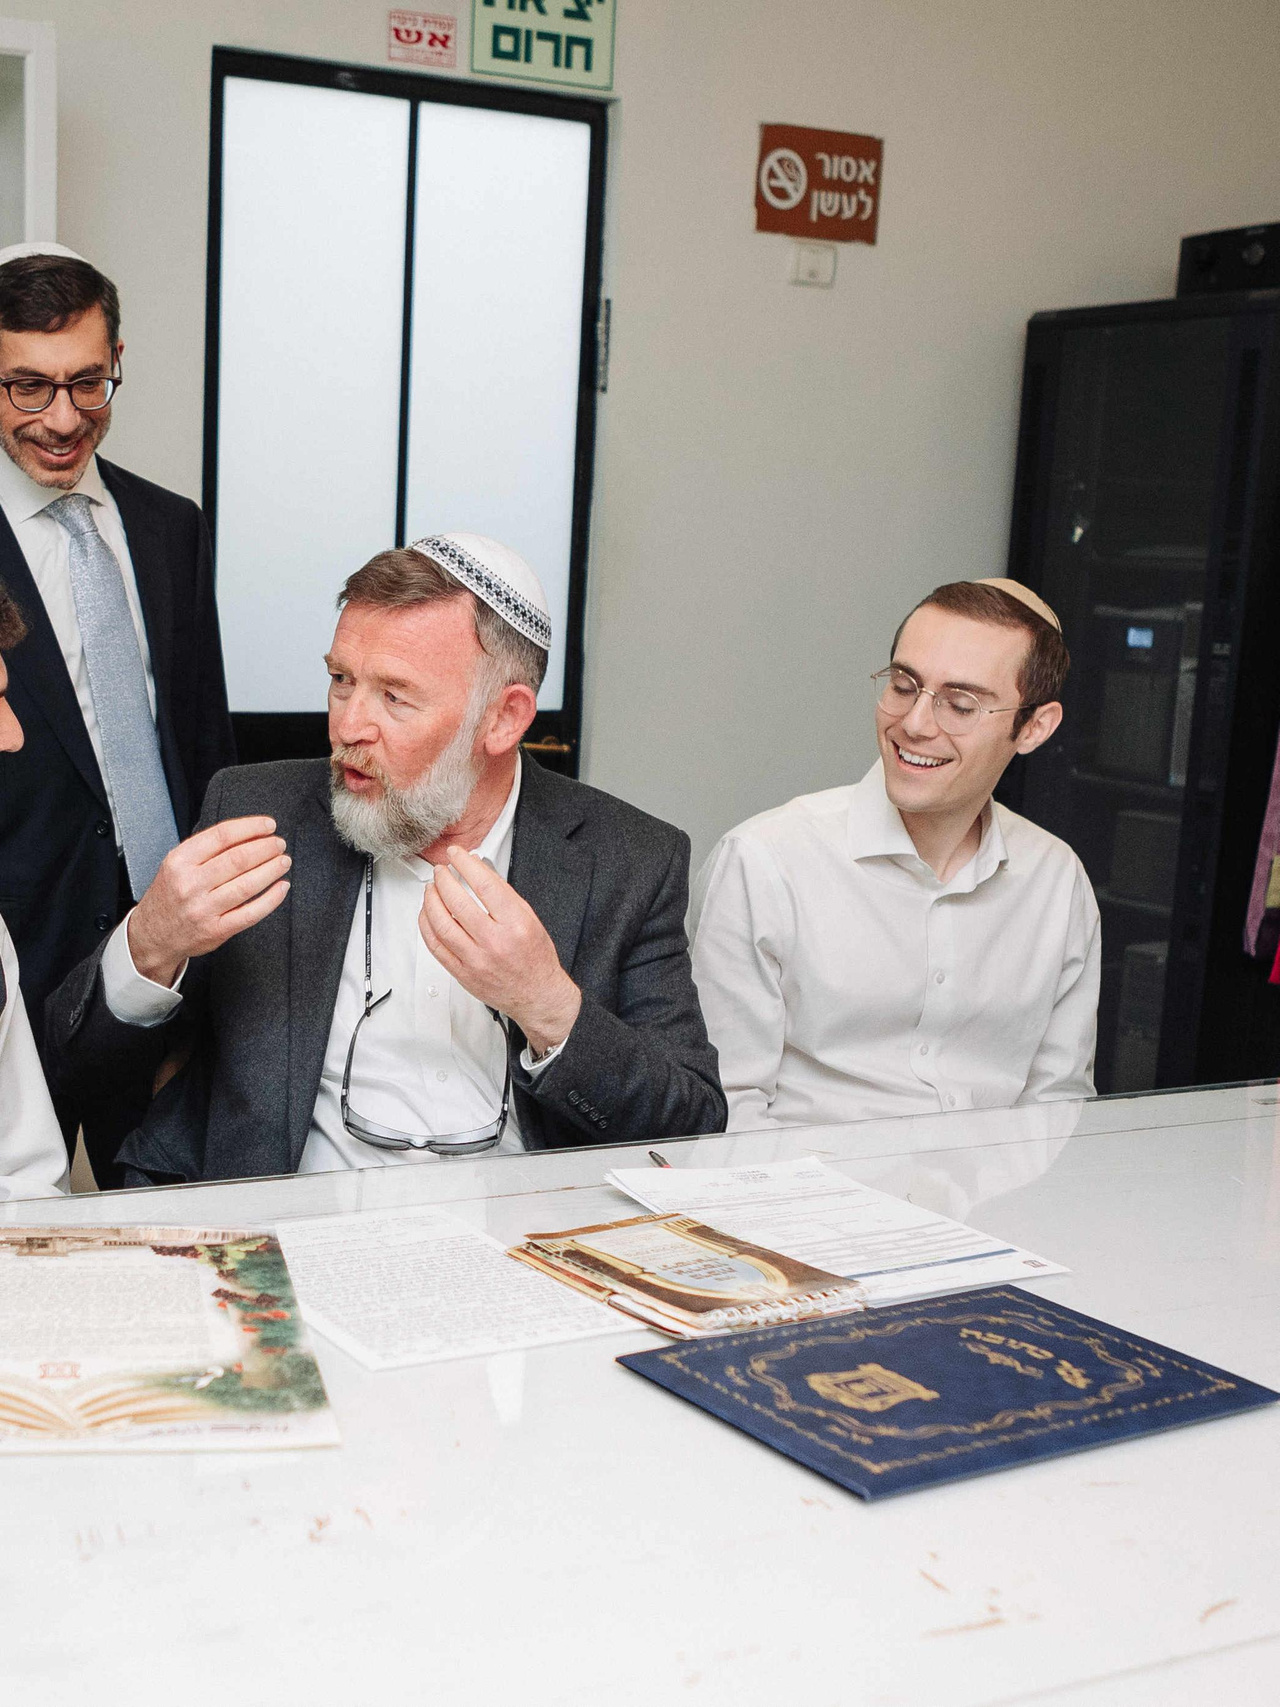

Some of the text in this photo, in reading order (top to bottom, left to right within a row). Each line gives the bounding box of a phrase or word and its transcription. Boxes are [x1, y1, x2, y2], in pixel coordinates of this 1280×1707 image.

[392, 27, 451, 49] אש
[491, 22, 593, 72] חרום
[815, 152, 877, 185] אסור
[809, 188, 874, 223] לעשן
